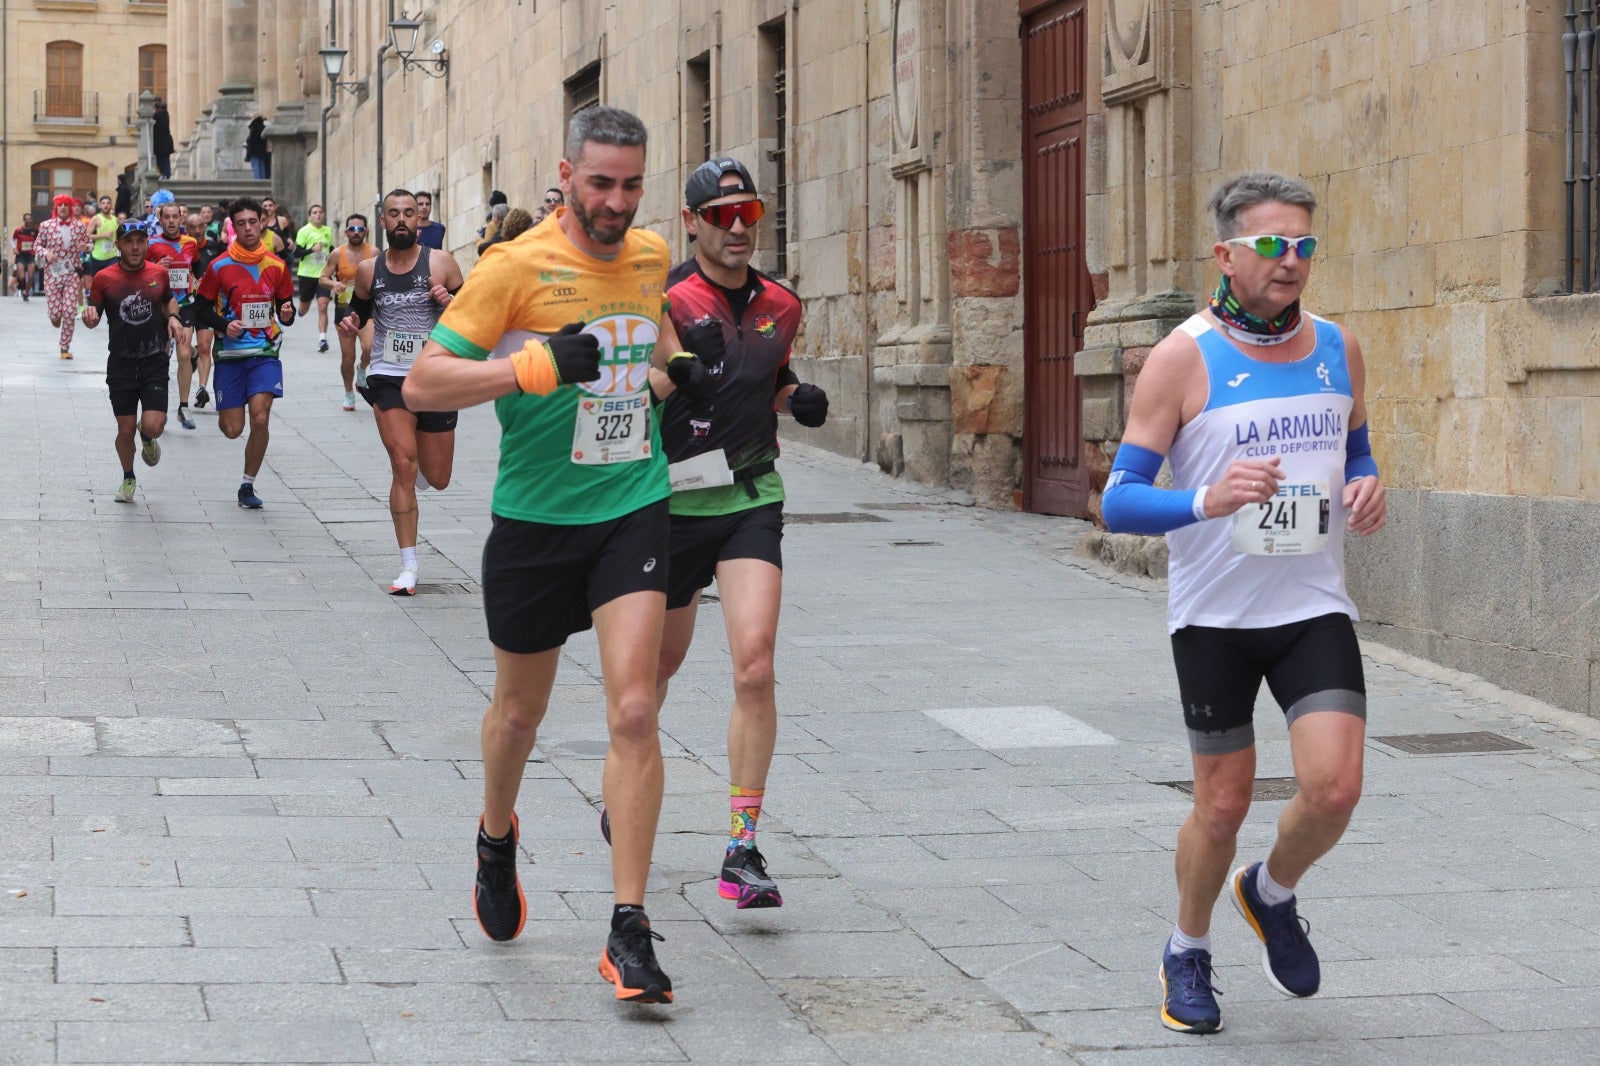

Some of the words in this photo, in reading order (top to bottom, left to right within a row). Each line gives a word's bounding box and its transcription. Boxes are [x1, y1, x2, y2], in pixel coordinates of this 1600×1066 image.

[249, 309, 266, 320] 844
[392, 339, 414, 353] 649
[603, 397, 648, 412] SETEL
[595, 413, 633, 441] 323
[1235, 420, 1260, 446] LA
[1267, 407, 1342, 441] ARMUÑA
[1246, 444, 1277, 457] CLUB
[1280, 439, 1340, 454] DEPORTIVO
[1276, 485, 1322, 497] ETEL
[1258, 500, 1297, 530] 241
